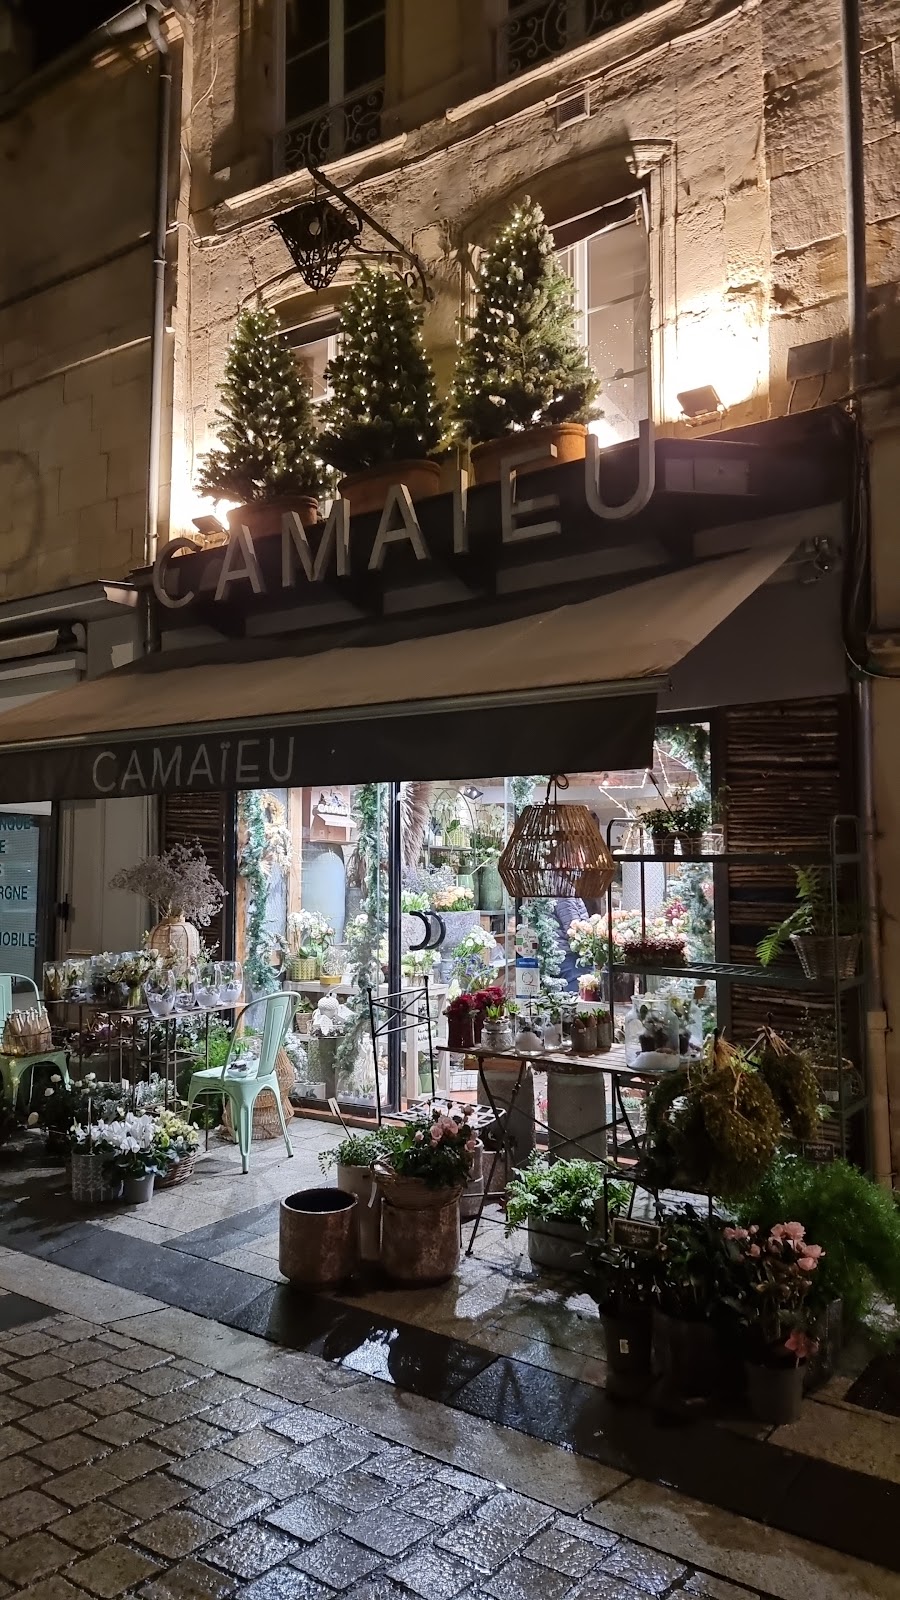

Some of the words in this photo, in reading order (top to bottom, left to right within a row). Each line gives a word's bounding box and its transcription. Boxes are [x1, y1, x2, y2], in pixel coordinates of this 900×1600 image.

[153, 419, 655, 609] CAMAIEU
[92, 736, 294, 793] CAMAÏEU
[0, 931, 36, 947] OBILE
